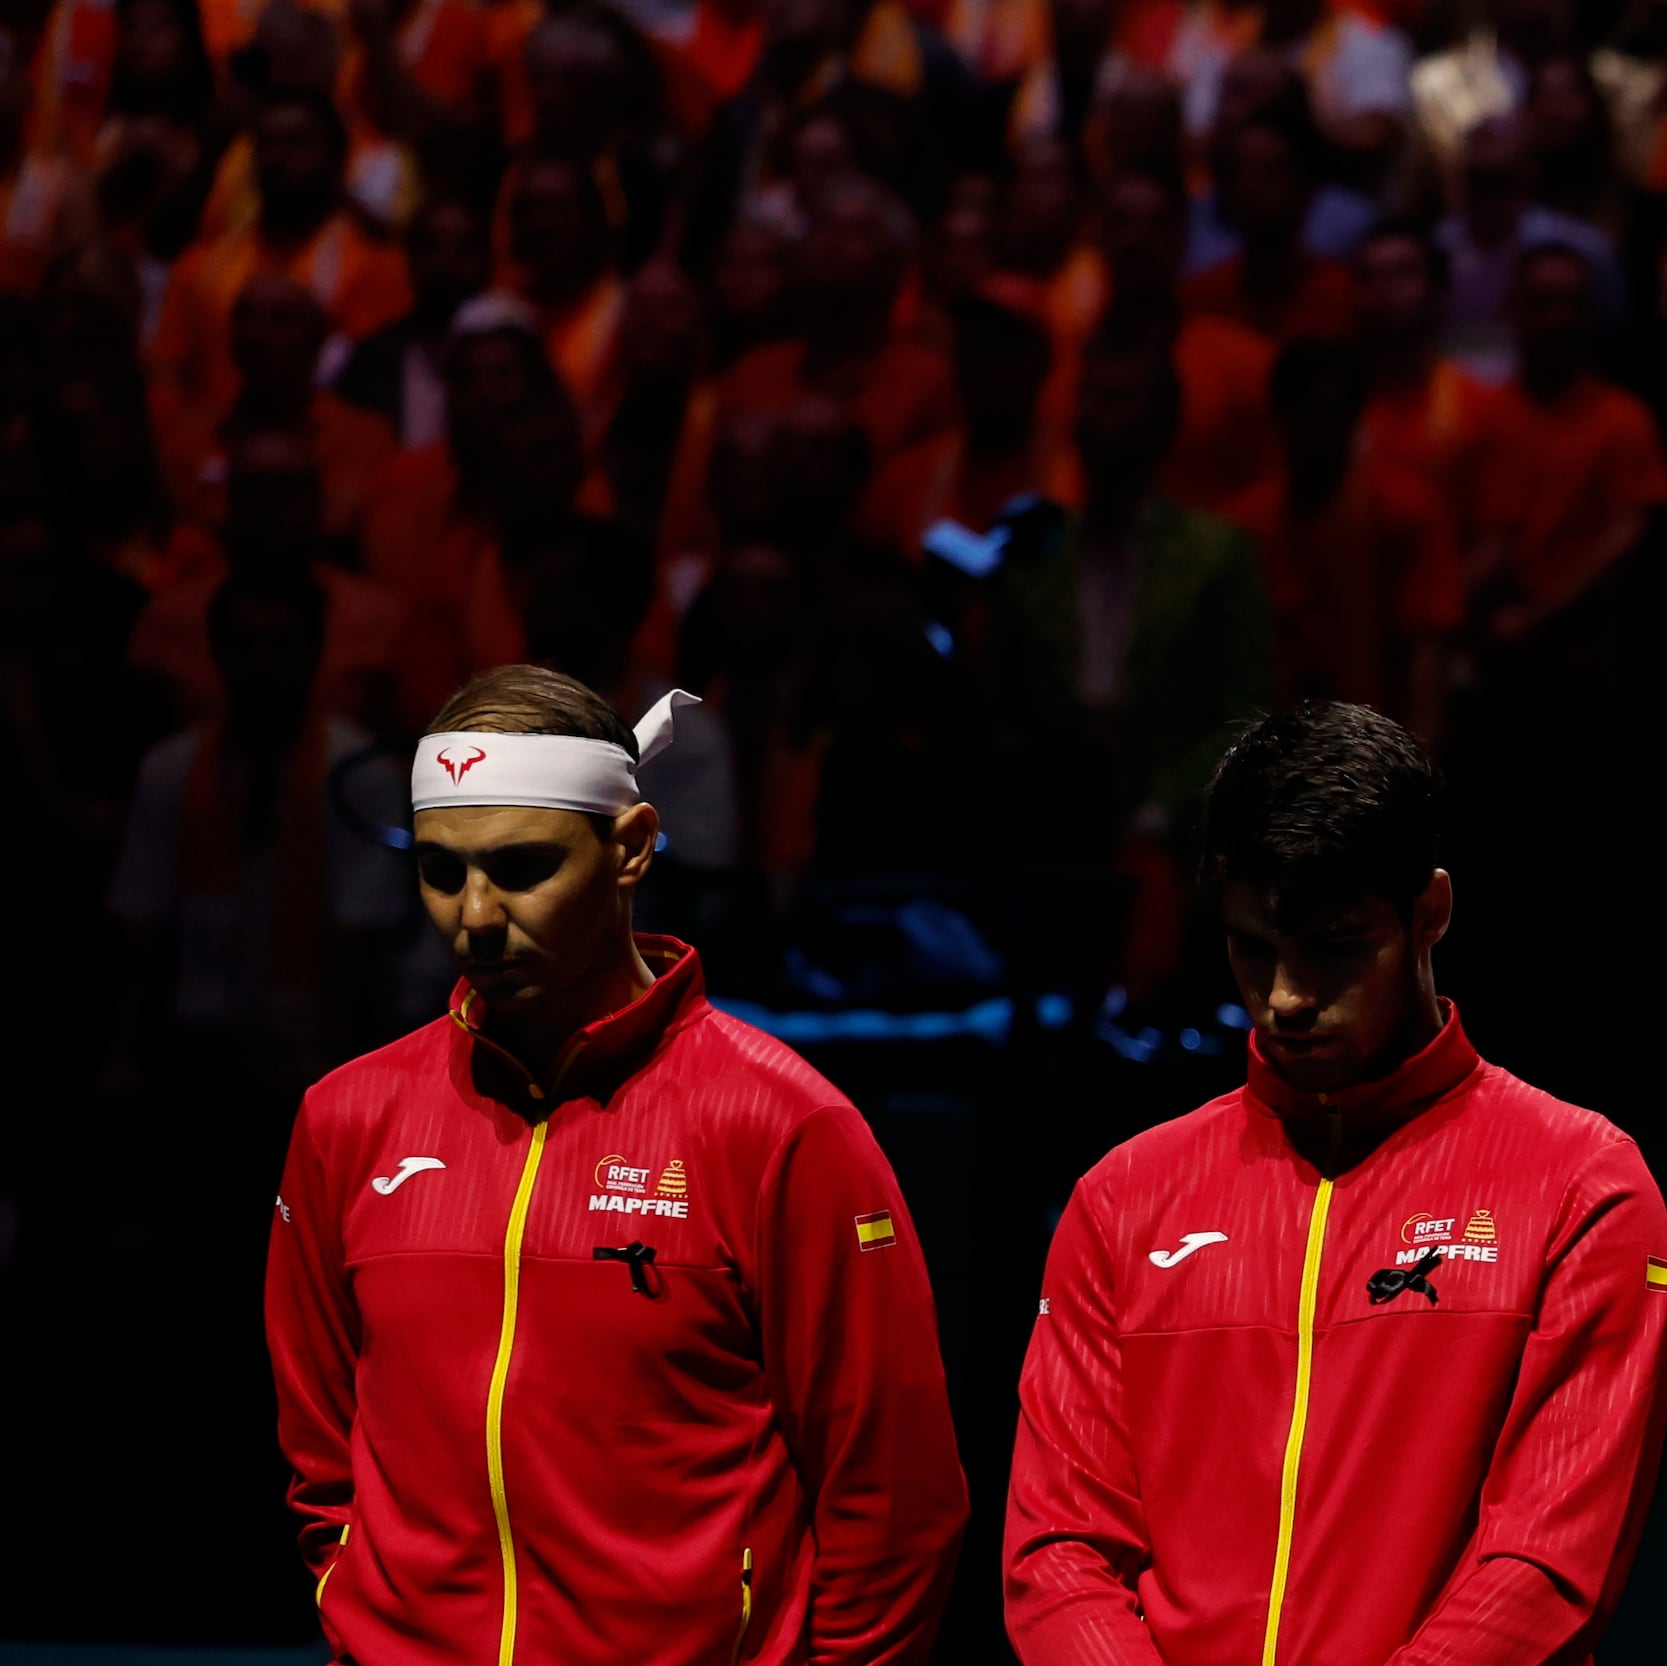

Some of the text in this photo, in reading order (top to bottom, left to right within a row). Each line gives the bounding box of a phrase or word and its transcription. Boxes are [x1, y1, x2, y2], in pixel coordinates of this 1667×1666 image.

[608, 1165, 650, 1183] RFET
[588, 1194, 689, 1219] MAPFRE
[1414, 1218, 1455, 1235] RFET
[1395, 1244, 1498, 1265] MAPFRE
